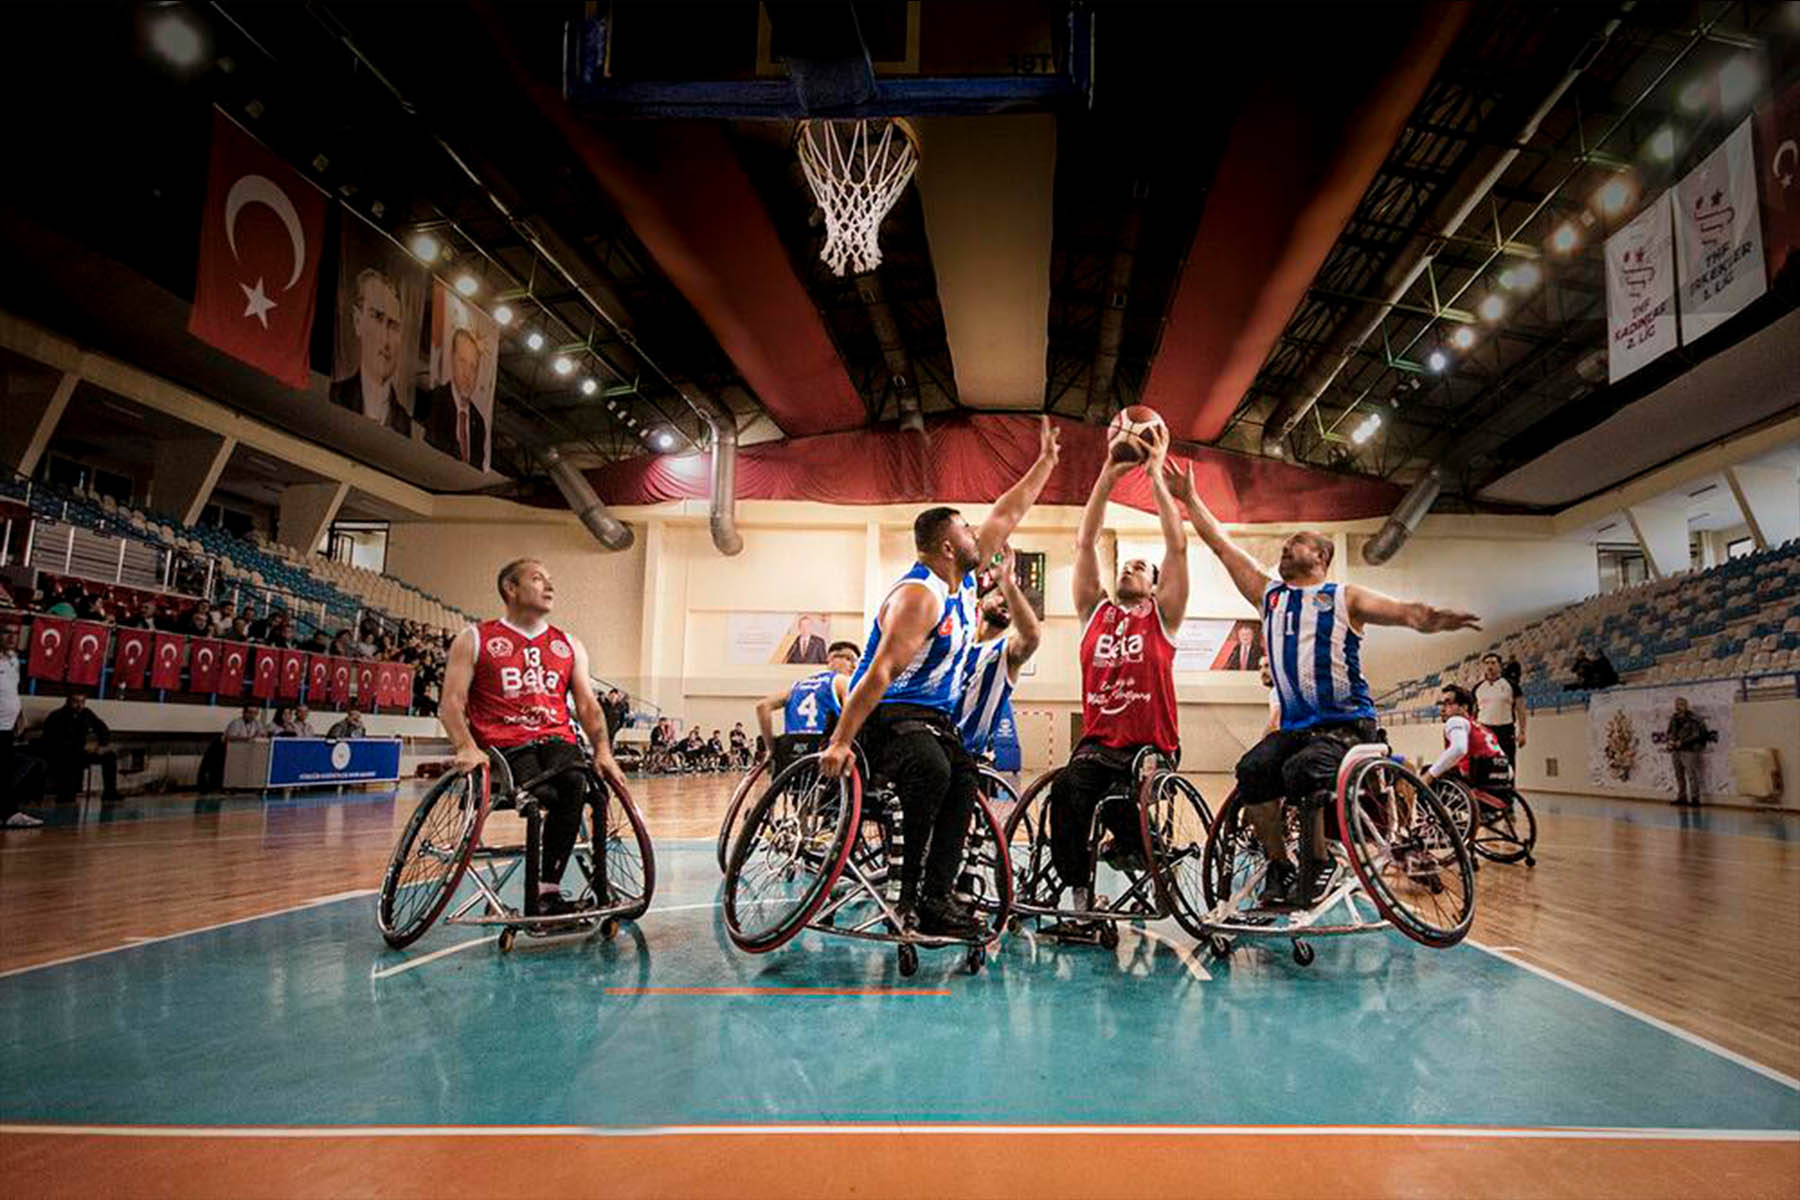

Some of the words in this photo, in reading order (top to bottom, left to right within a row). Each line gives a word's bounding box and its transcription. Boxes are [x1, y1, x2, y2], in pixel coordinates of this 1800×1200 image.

[1285, 611, 1295, 636] 1
[523, 647, 541, 668] 13
[797, 692, 818, 728] 4
